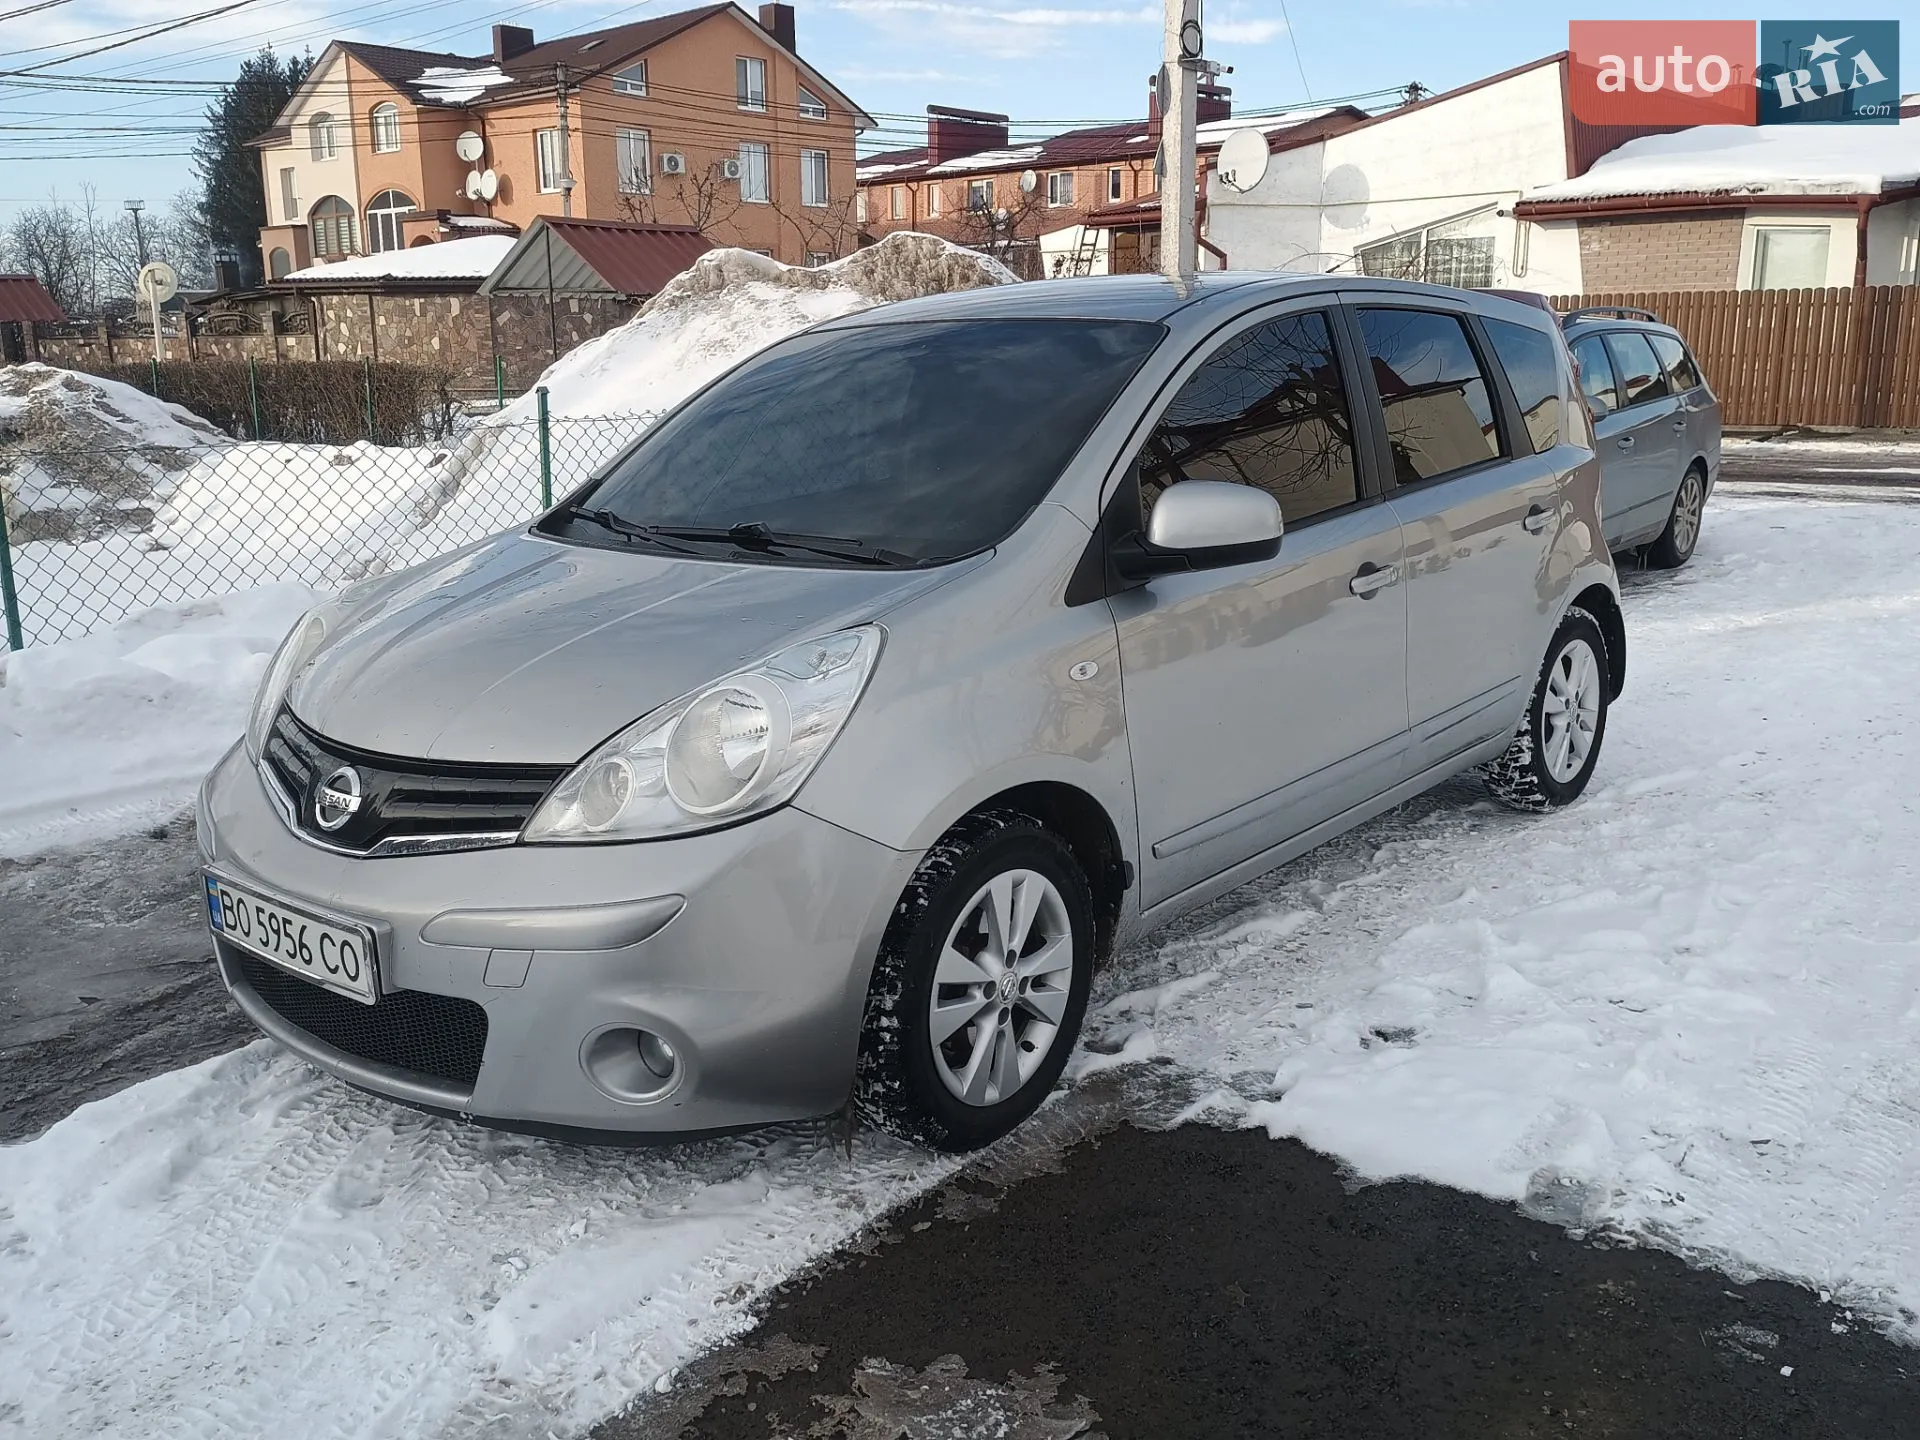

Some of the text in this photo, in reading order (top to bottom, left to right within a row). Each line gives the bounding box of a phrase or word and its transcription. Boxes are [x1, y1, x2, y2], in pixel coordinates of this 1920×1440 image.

[219, 888, 360, 983] BO 5956 CO
